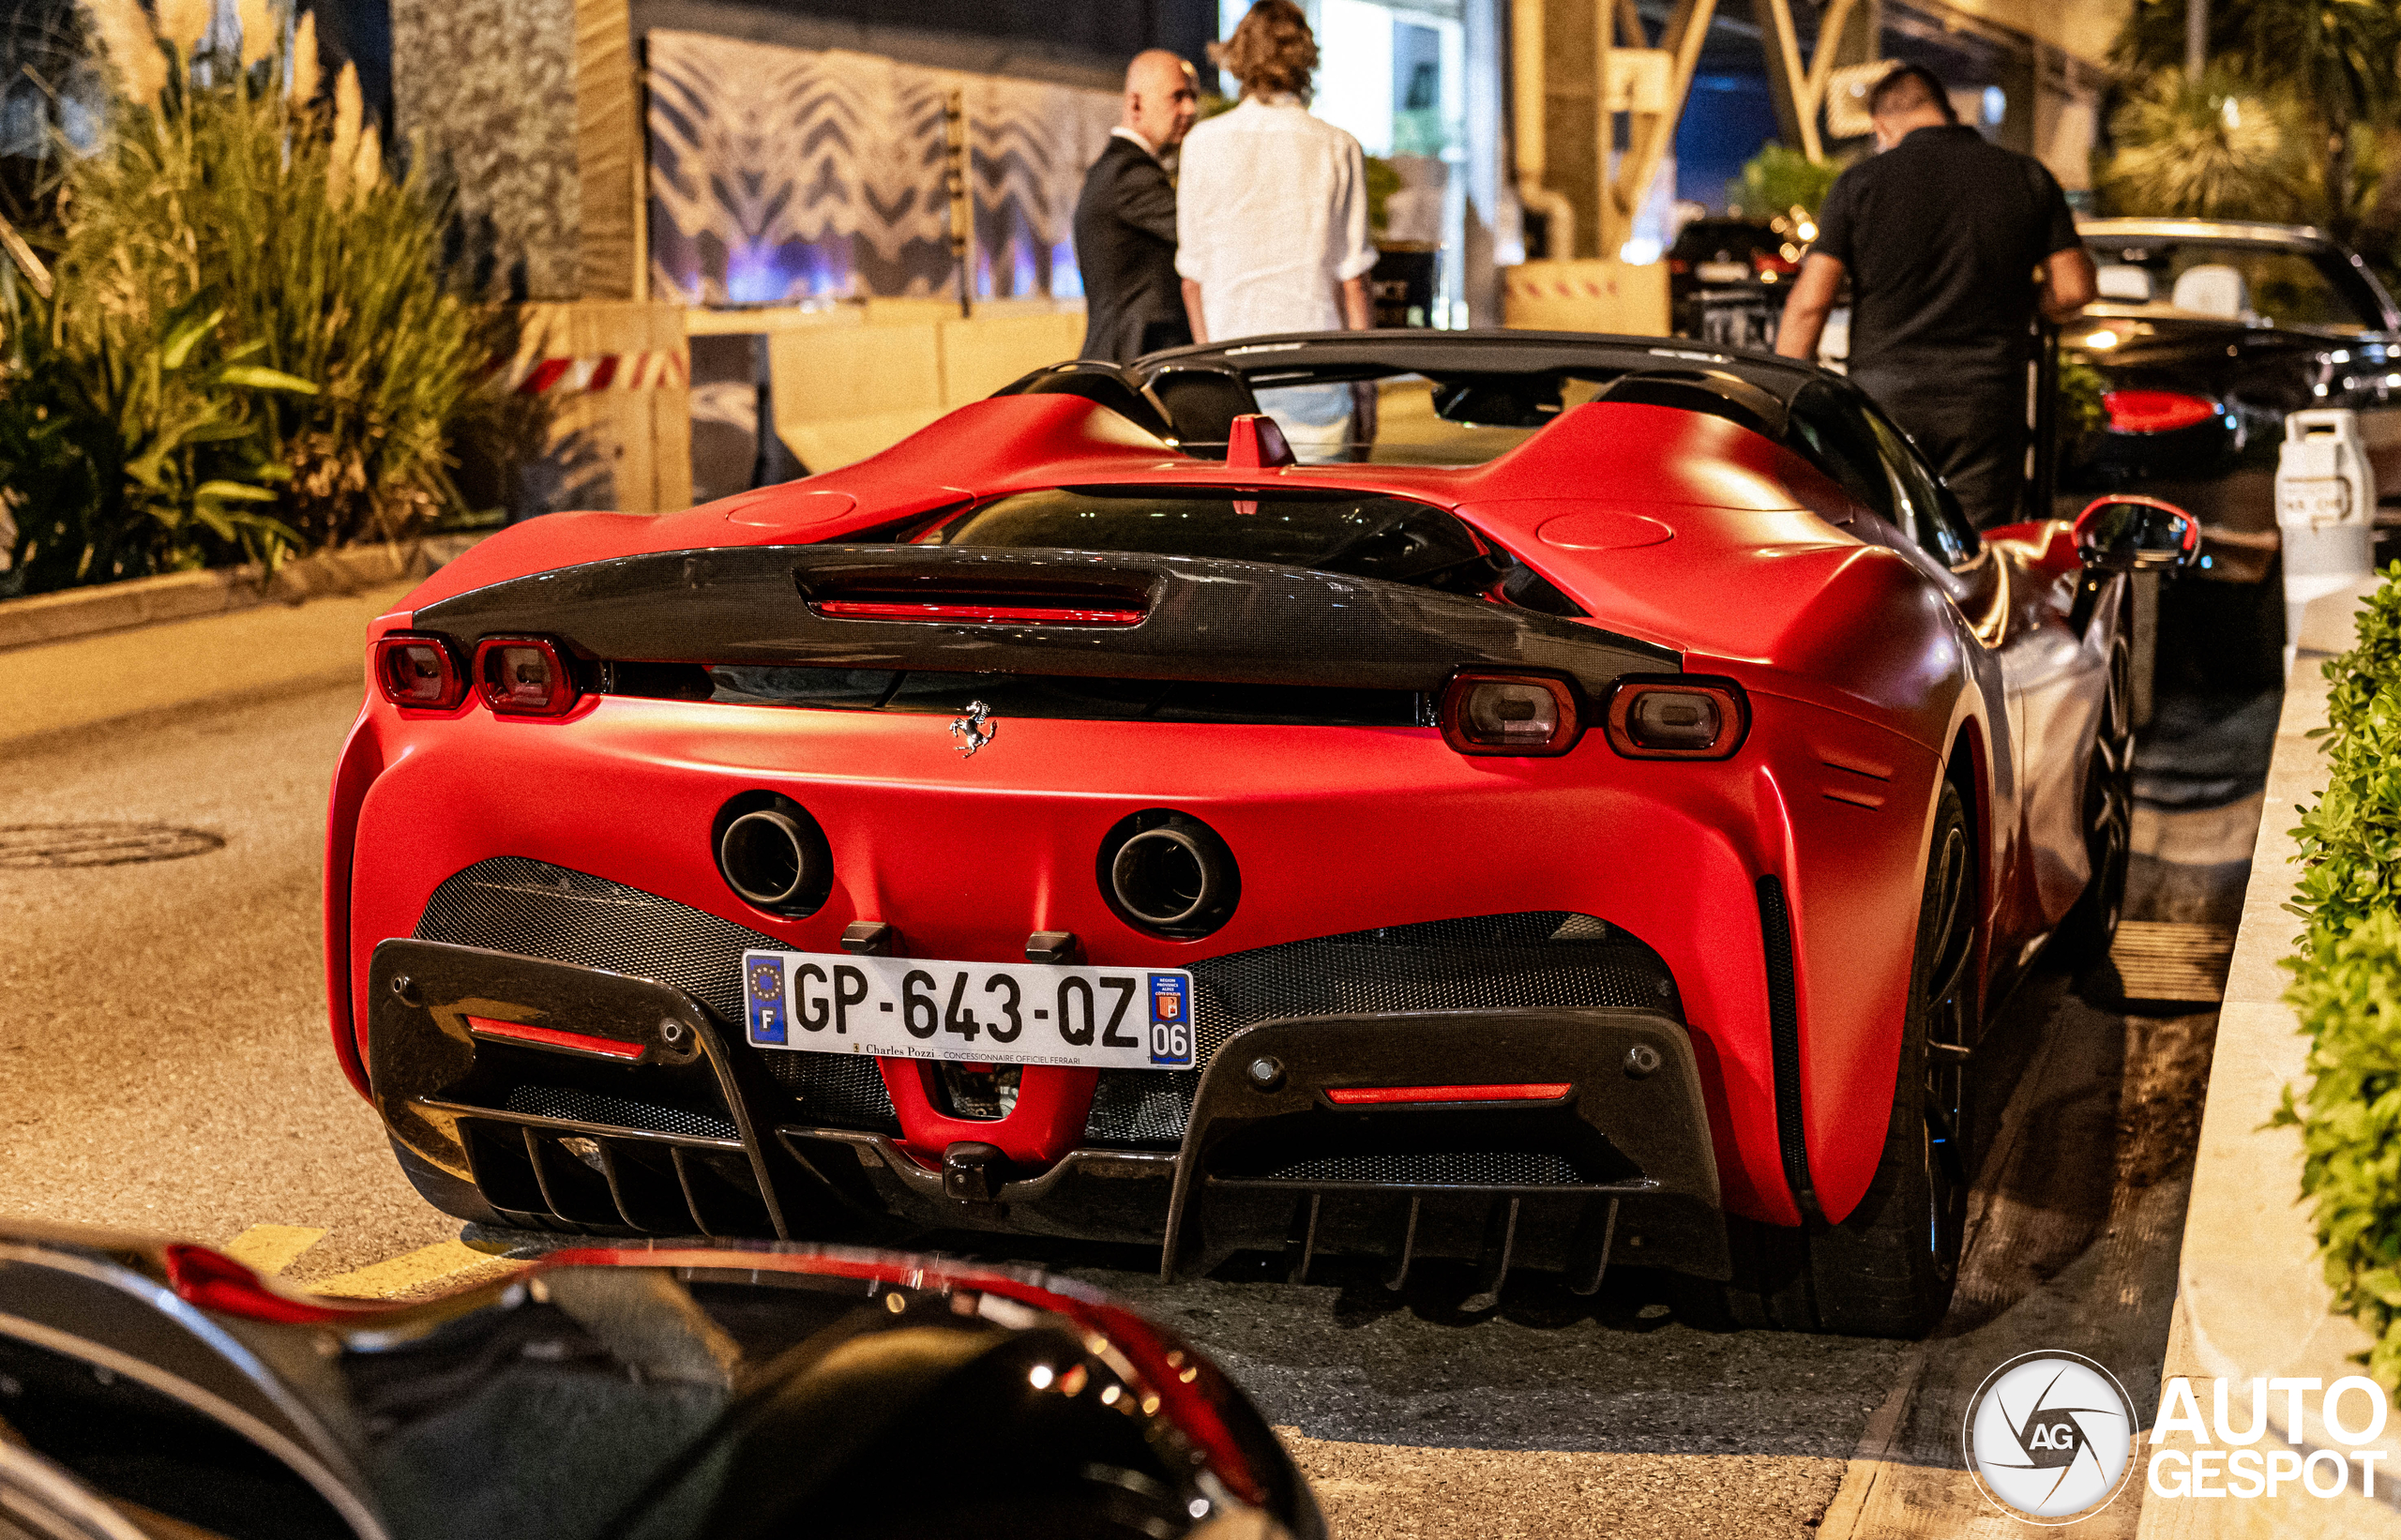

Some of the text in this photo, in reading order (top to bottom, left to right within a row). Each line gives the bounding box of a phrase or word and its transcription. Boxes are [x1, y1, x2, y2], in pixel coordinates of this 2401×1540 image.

[793, 963, 1139, 1048] GP-643-QZ
[762, 1010, 773, 1029] F
[1152, 1024, 1187, 1056] 06
[866, 1044, 903, 1055] Charles
[908, 1046, 935, 1057] Pozzi
[944, 1051, 1014, 1062] CONCESSIONNAIRE
[1016, 1055, 1049, 1063] OFFICIEL
